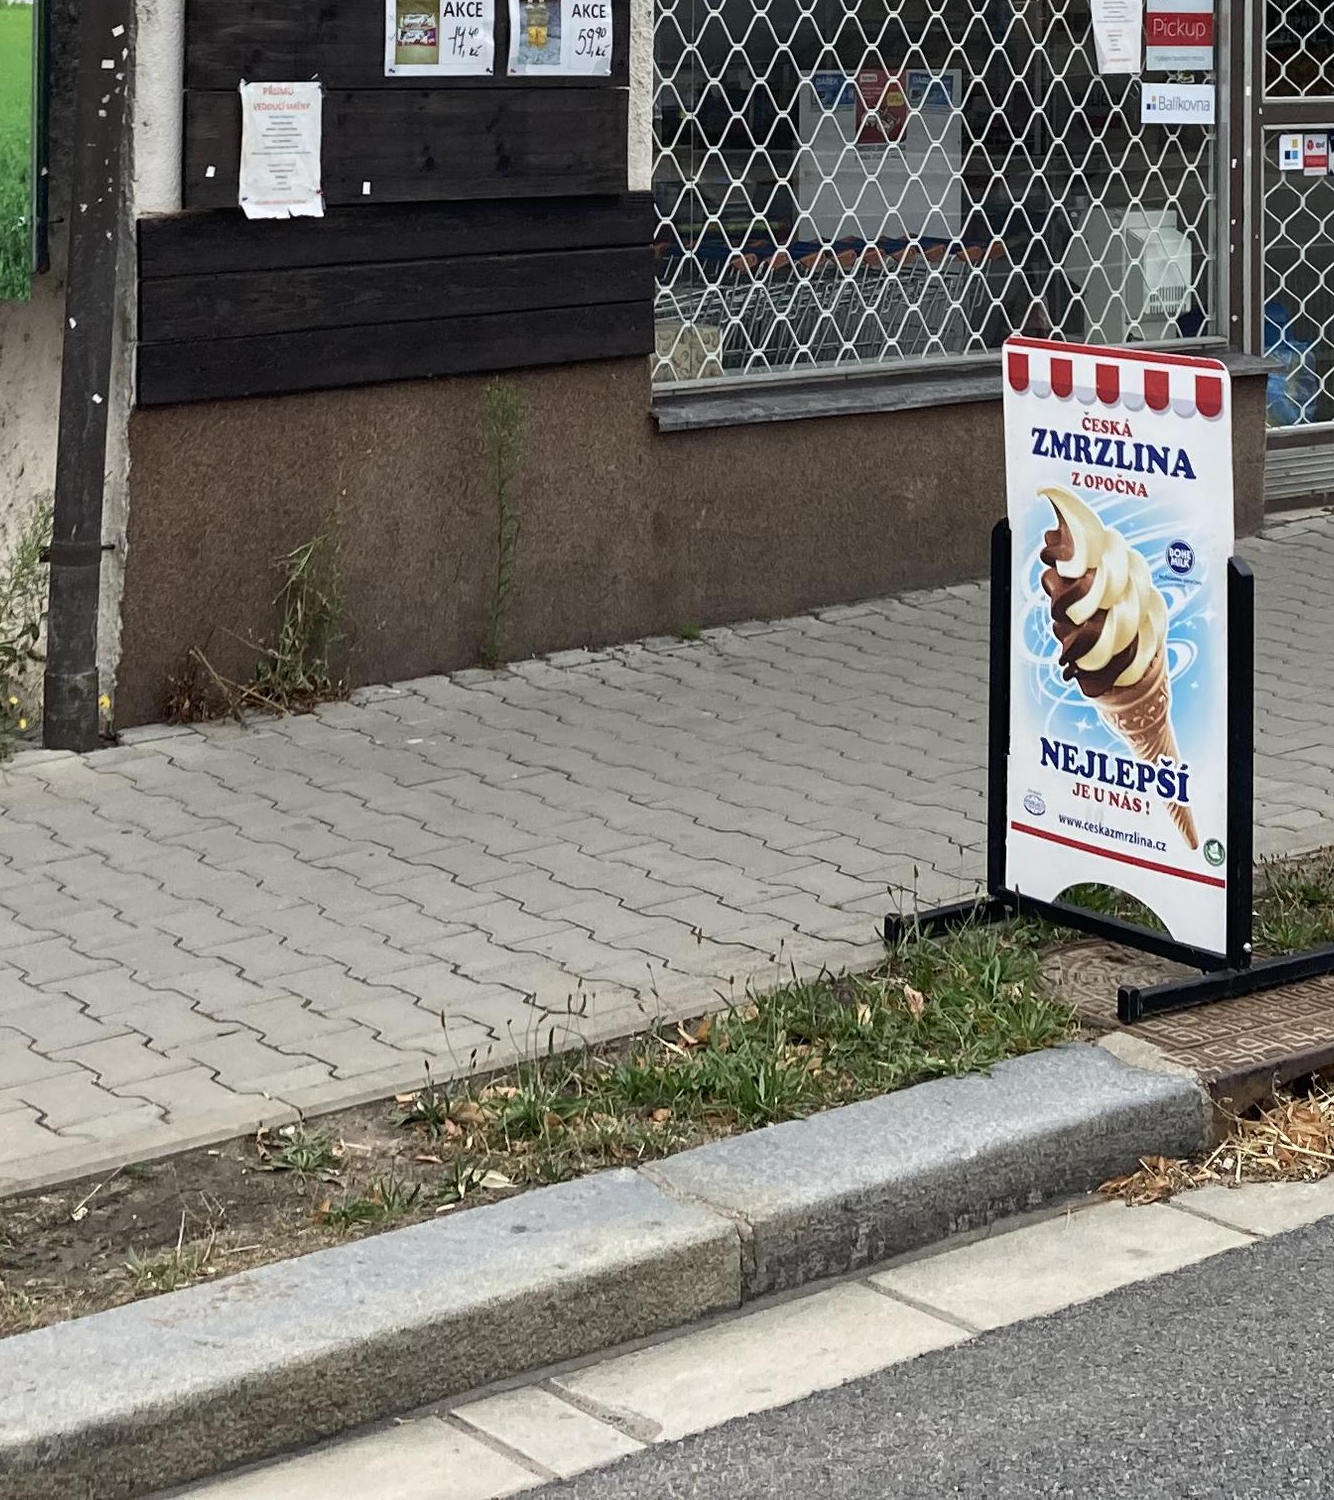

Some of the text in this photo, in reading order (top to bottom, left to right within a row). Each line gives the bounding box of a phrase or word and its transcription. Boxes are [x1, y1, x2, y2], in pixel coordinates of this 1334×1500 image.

[443, 1, 483, 17] AKCE
[571, 3, 607, 18] AKCE
[1153, 18, 1206, 41] Pickup
[1158, 95, 1210, 112] Balíkovna
[1082, 411, 1133, 437] ČESKÁ
[1031, 427, 1197, 480] ZMRZLINA
[1071, 471, 1149, 498] Z OPOČNA
[1170, 557, 1191, 568] MILK
[1040, 736, 1190, 803] NEJLEPŠÍ
[1072, 782, 1091, 799] JE
[1094, 787, 1104, 803] U
[1058, 813, 1167, 852] www.ceskazmrzlina.cz
